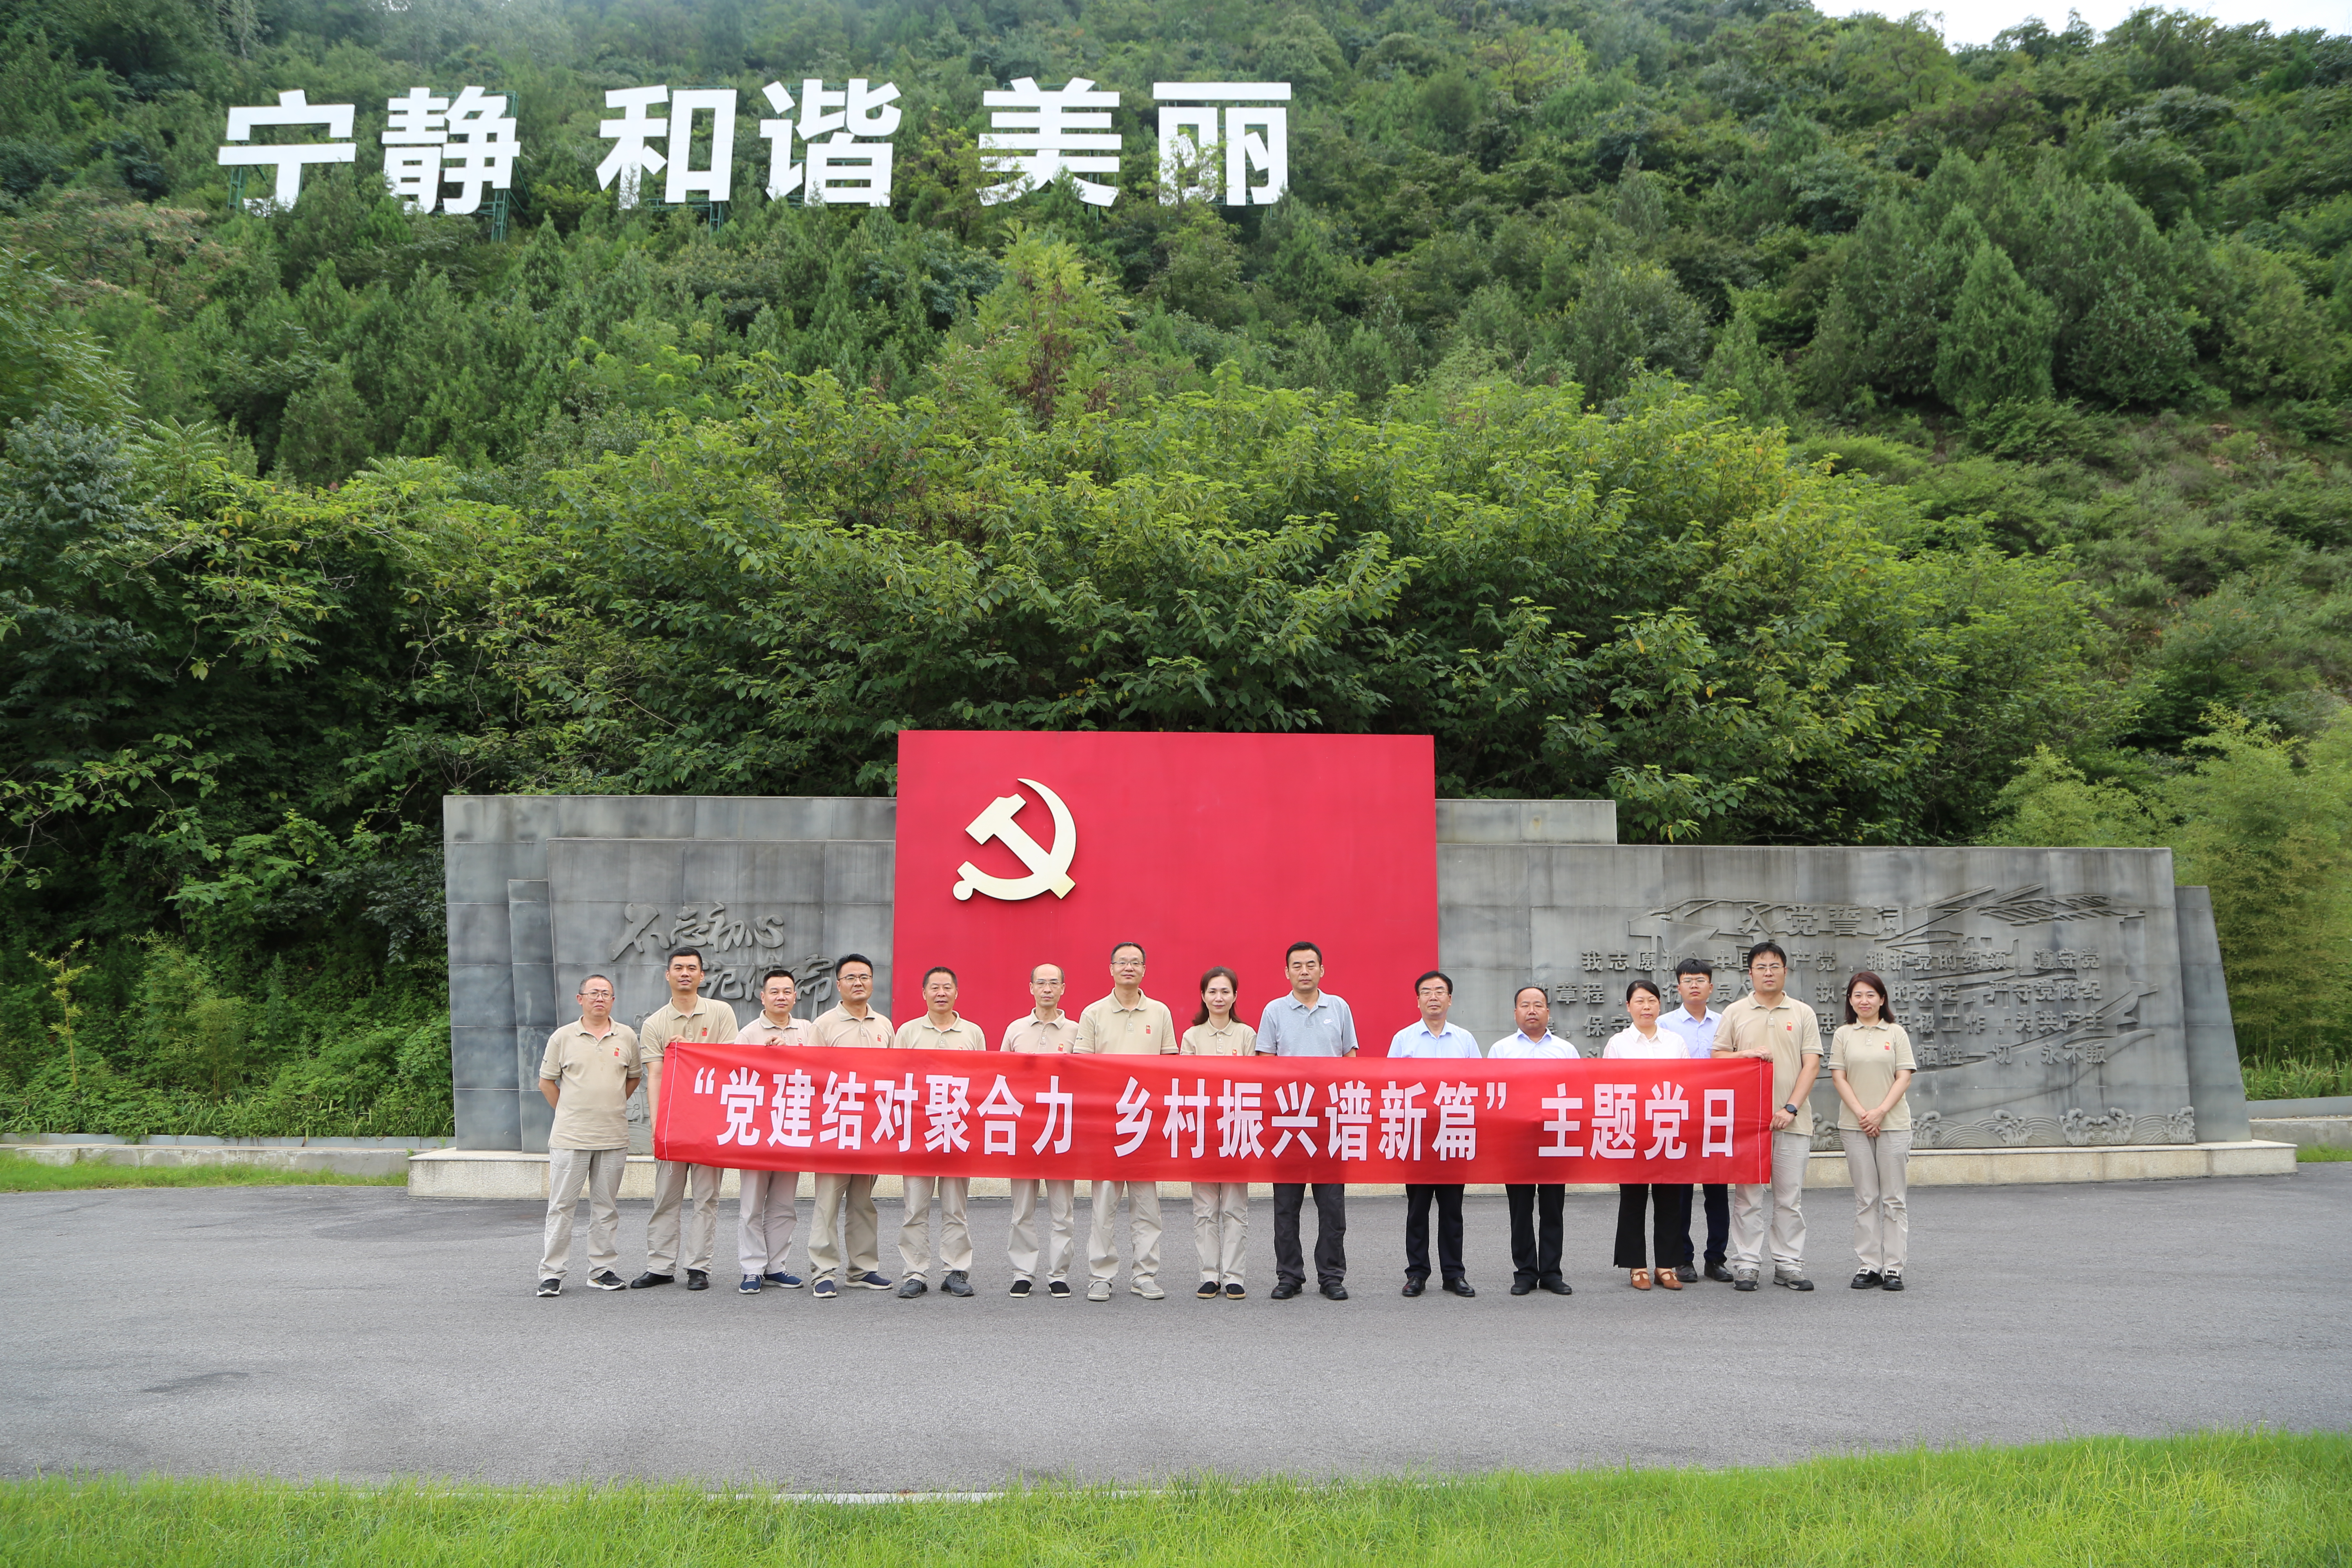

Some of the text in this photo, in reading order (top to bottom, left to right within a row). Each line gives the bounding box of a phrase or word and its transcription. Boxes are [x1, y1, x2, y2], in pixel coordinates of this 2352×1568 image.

[218, 77, 1292, 215] 宁静 和谐 美丽
[609, 901, 784, 961] 不忘初心
[1739, 905, 1904, 935] 入党誓词
[694, 1067, 1735, 1161] “党建结对聚合力 乡村振兴谱新篇” 主题党日
